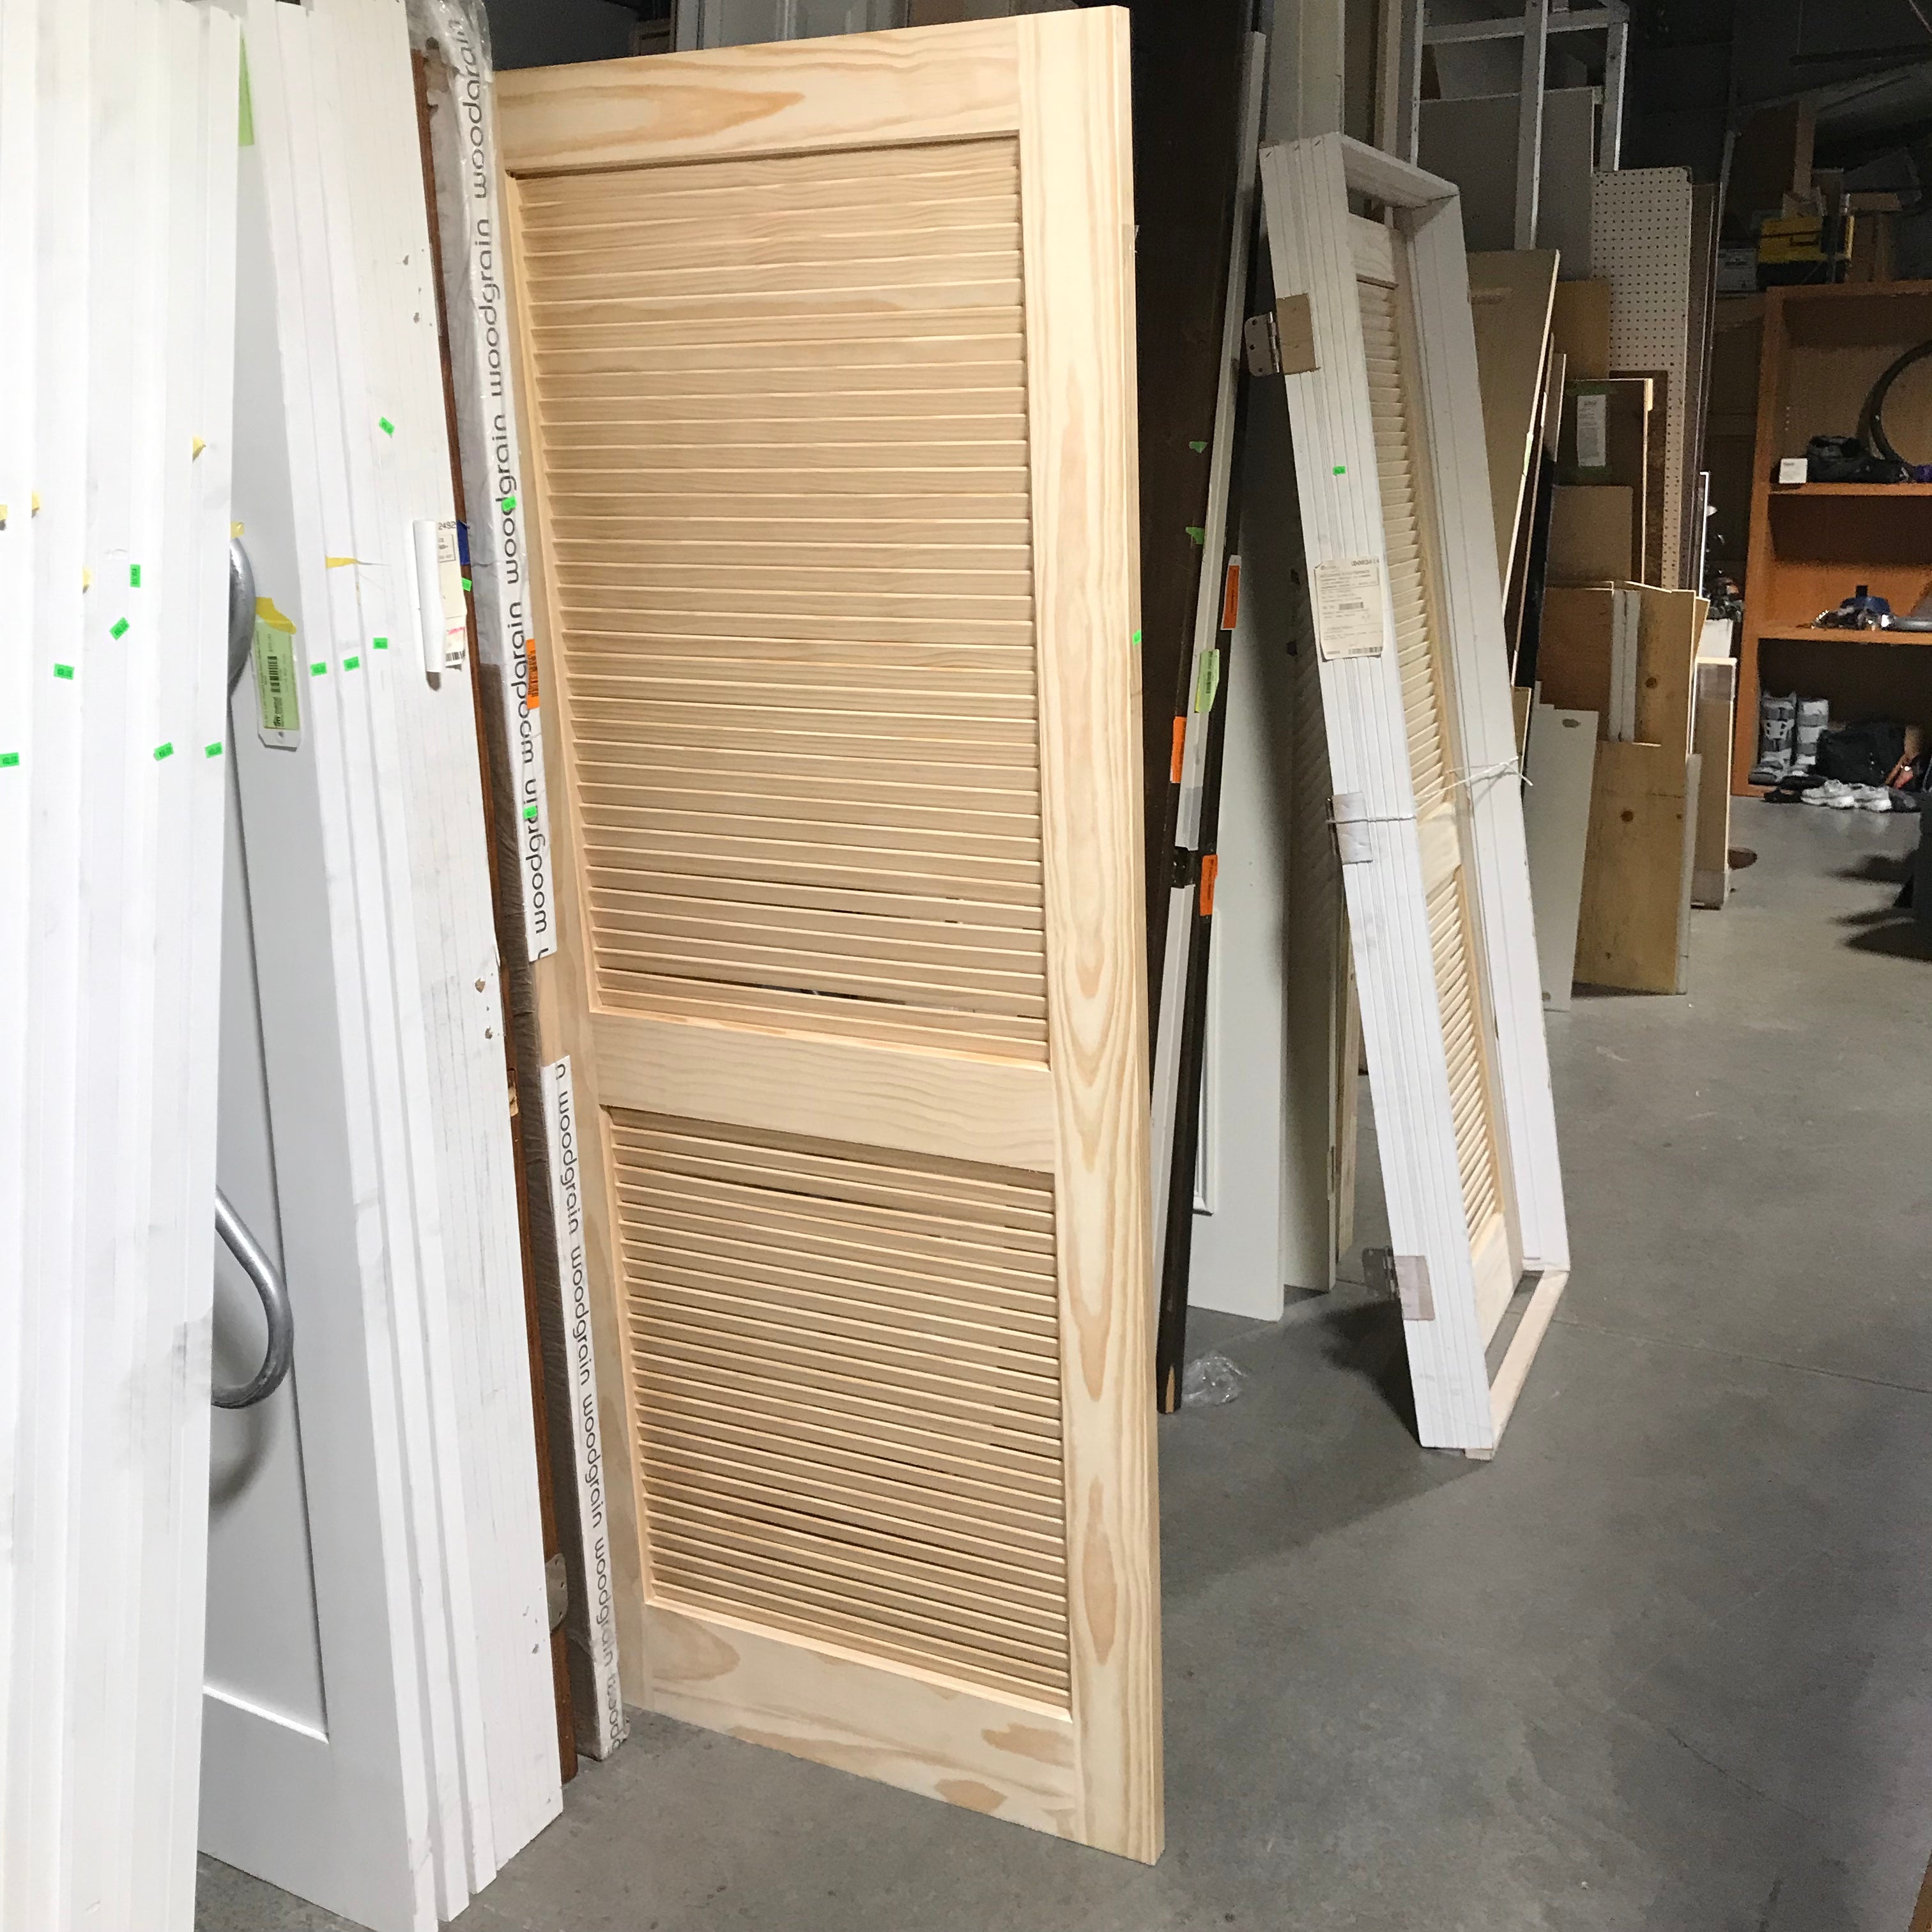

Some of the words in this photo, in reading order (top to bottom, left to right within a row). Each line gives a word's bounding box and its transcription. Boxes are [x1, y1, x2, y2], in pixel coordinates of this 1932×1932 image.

[474, 218, 502, 397] woodgrain
[559, 1090, 581, 1235] woodgrain
[570, 1245, 592, 1386] woodgrain
[583, 1393, 604, 1528] woodgrain
